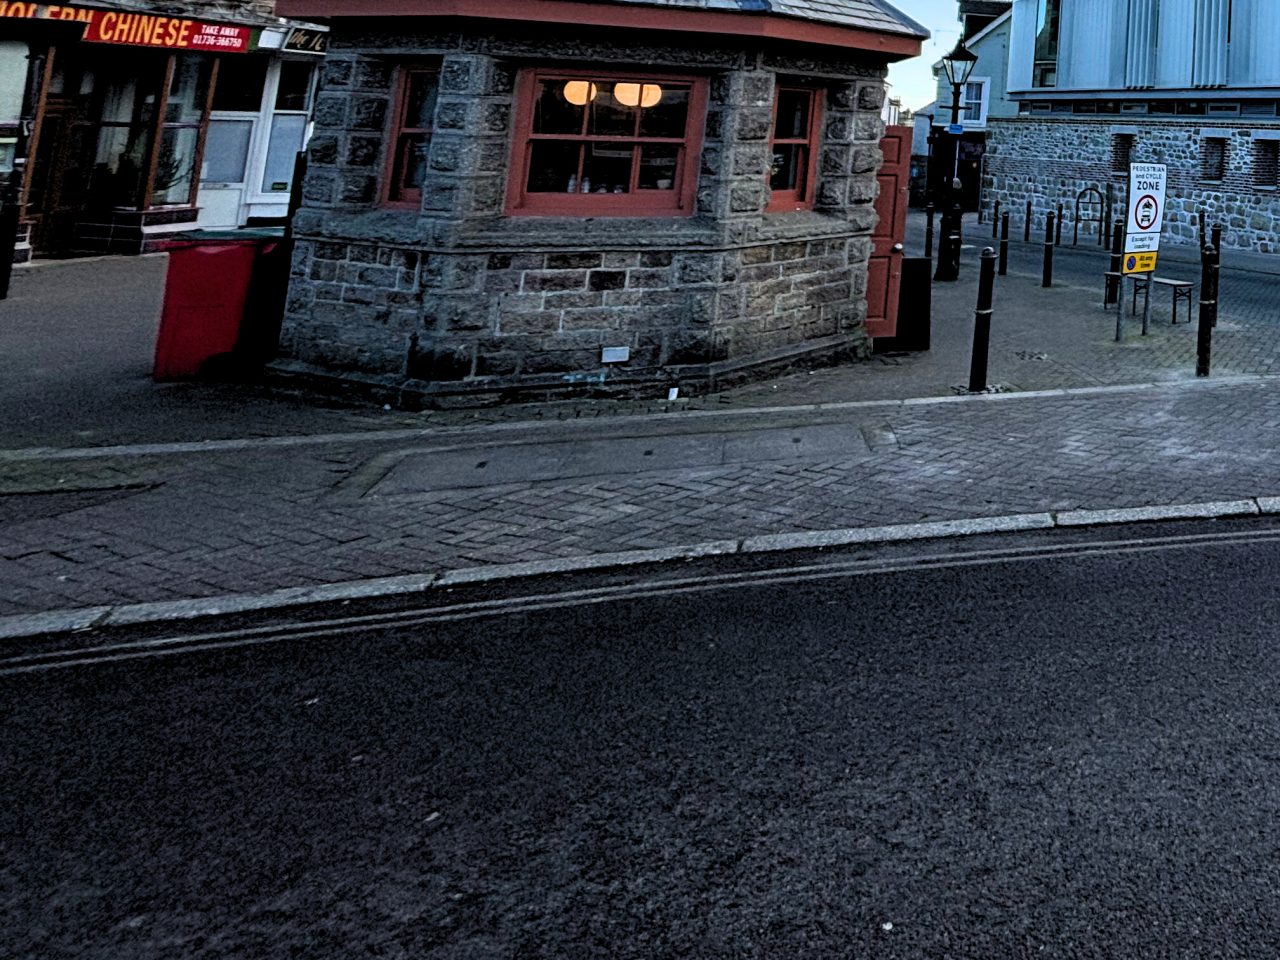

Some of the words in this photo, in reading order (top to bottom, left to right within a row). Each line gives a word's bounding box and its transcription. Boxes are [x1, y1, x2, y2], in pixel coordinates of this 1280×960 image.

[99, 11, 194, 47] CHINESE
[201, 24, 220, 35] TAKE
[220, 26, 240, 37] AWAY
[192, 34, 243, 48] 01736-366750
[1137, 181, 1159, 190] ZONE
